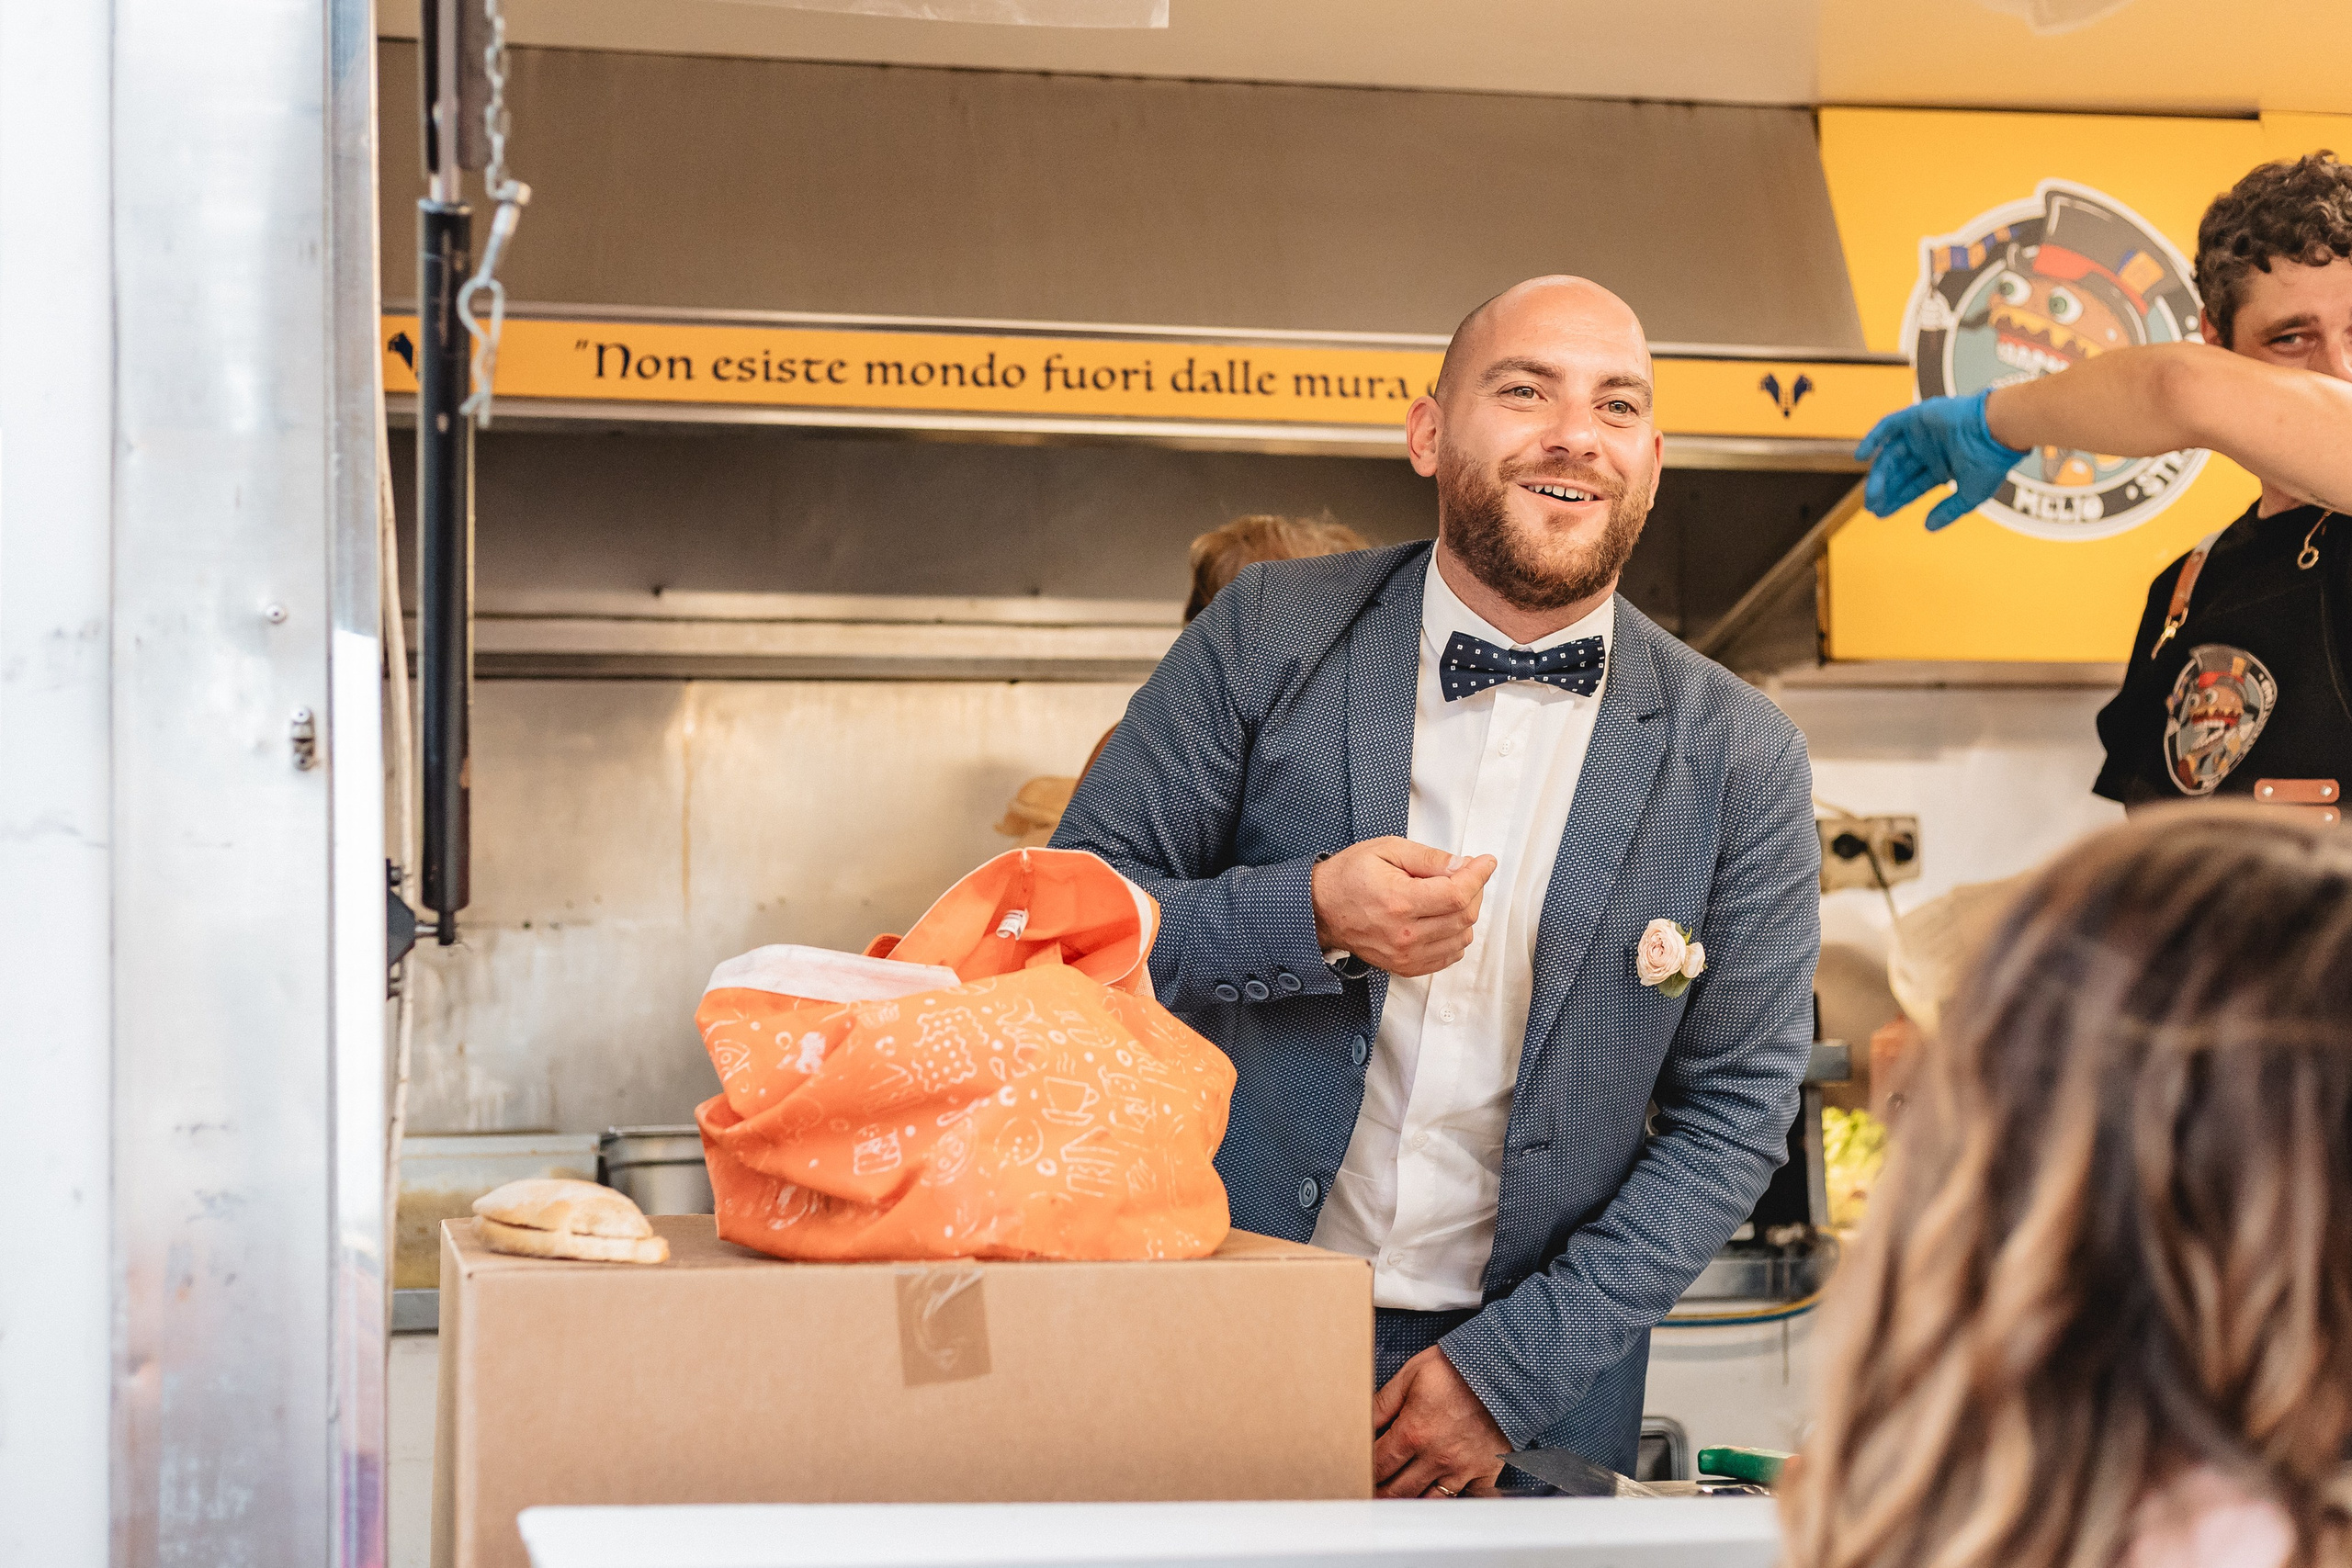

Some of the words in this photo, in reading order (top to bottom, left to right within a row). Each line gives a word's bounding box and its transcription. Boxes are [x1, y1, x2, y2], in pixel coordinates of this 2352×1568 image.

[711, 348, 849, 385] esiste
[865, 351, 1027, 389] mondo
[1043, 353, 1155, 393] fuori
[1170, 356, 1277, 396] dalle
[1293, 373, 1410, 400] mura
